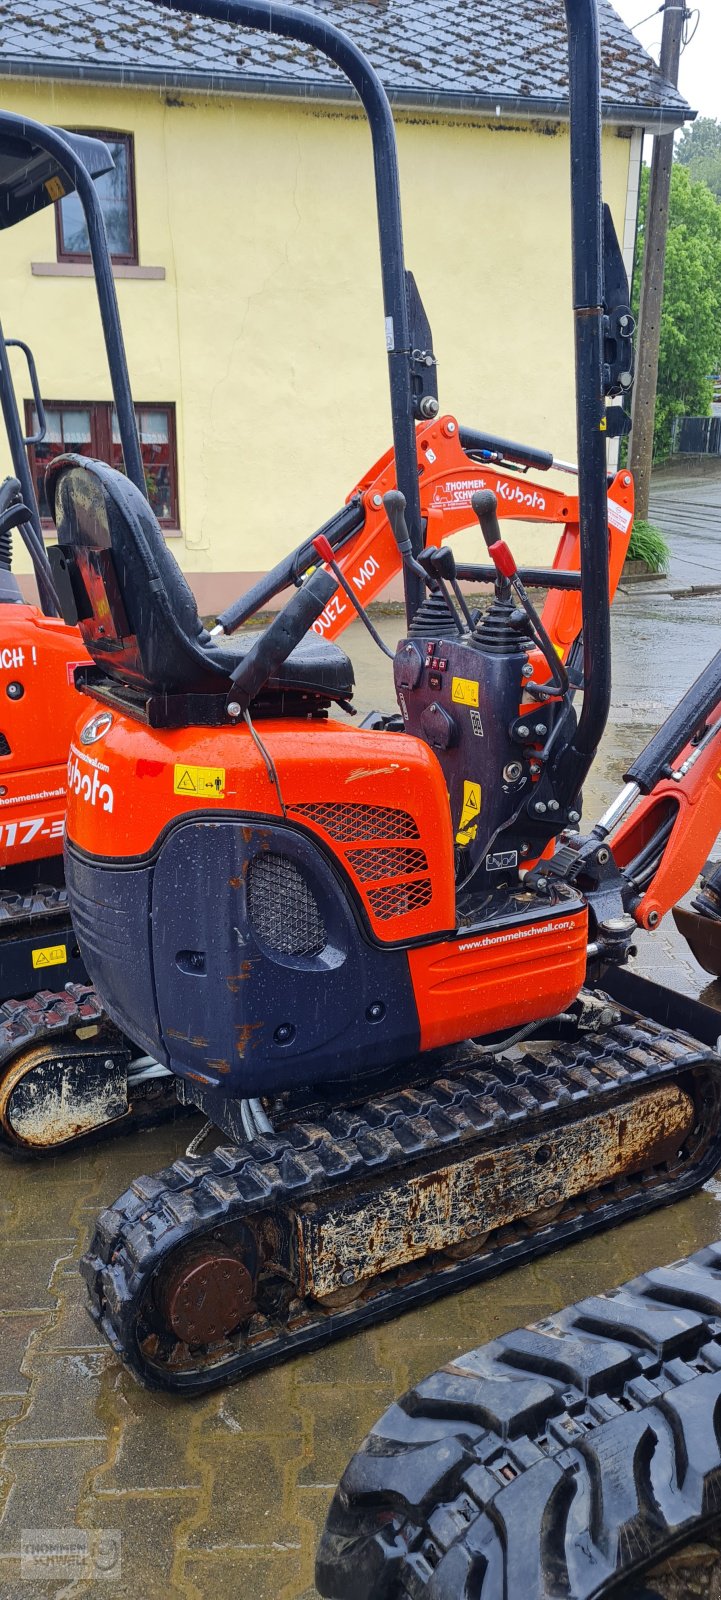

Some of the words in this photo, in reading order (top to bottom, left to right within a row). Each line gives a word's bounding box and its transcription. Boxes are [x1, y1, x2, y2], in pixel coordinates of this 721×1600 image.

[446, 479, 486, 491] THOMMEN-
[453, 490, 480, 502] SCHW
[496, 480, 546, 511] Kubota
[311, 596, 347, 636] OUEZ
[352, 555, 380, 590] MOI
[458, 921, 574, 951] www.thommenschwall.com
